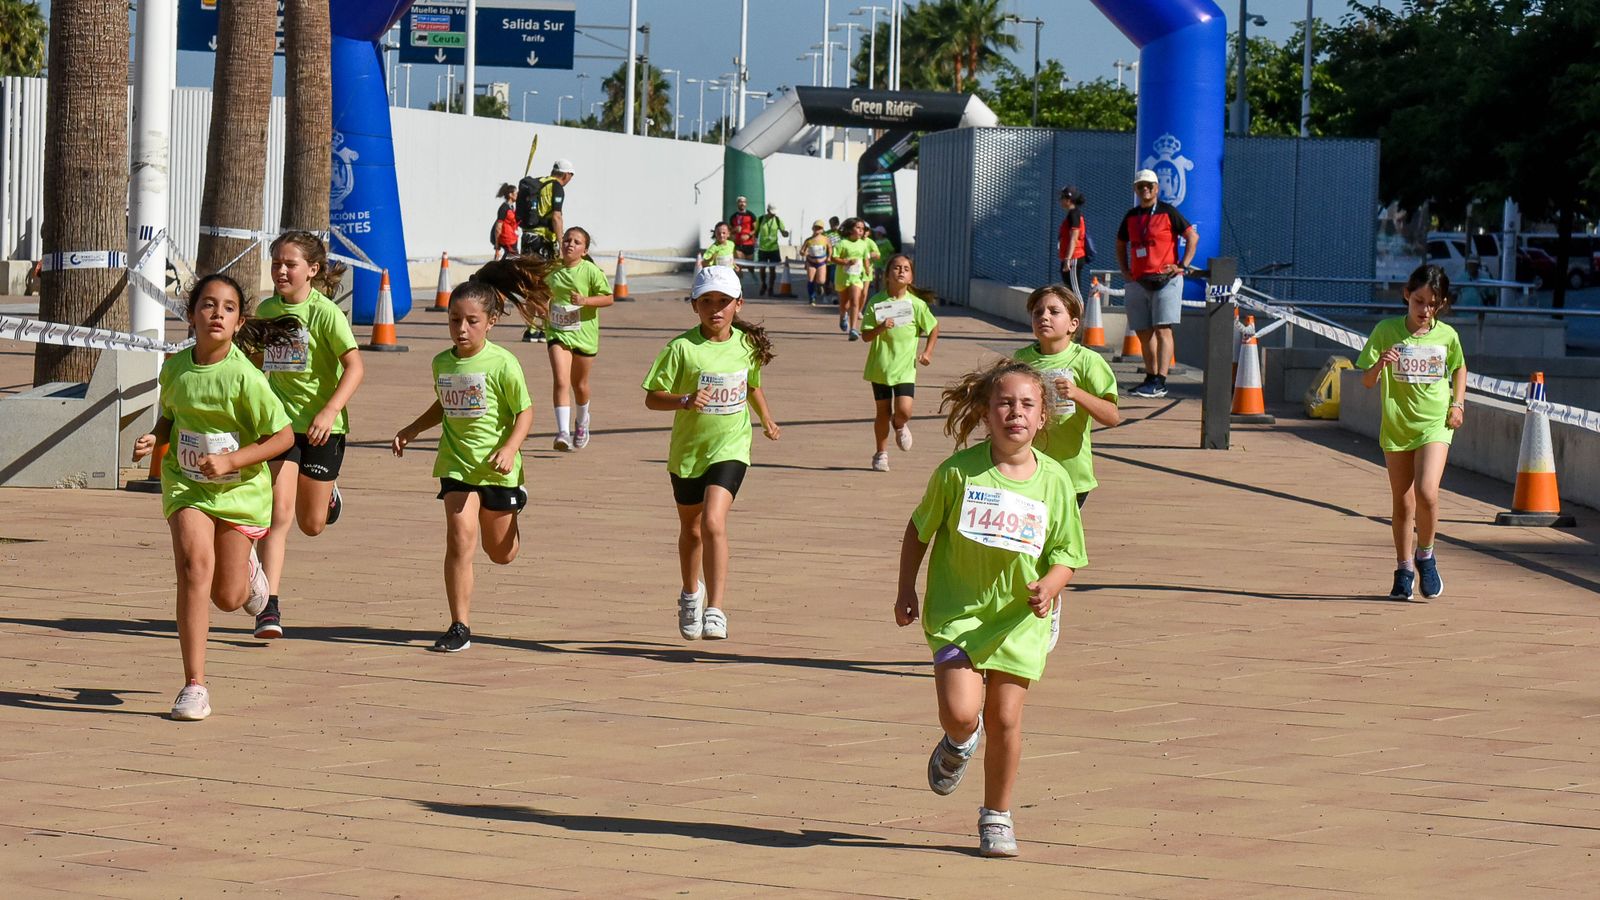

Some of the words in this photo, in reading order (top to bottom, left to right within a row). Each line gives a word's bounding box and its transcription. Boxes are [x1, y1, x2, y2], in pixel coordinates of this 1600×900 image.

[410, 6, 438, 14] Muelle
[502, 18, 540, 30] Salida
[543, 20, 565, 31] Sur
[432, 34, 460, 44] Ceuta
[521, 34, 545, 42] Tarifa
[851, 97, 883, 114] Green
[885, 100, 916, 117] Rider
[329, 211, 356, 221] ACIÓN
[357, 210, 370, 220] DE
[340, 221, 372, 234] RTES
[1397, 357, 1427, 373] 1398
[440, 389, 466, 406] 1407
[711, 387, 738, 403] 405
[967, 490, 985, 501] XXI
[967, 507, 1020, 534] 1449
